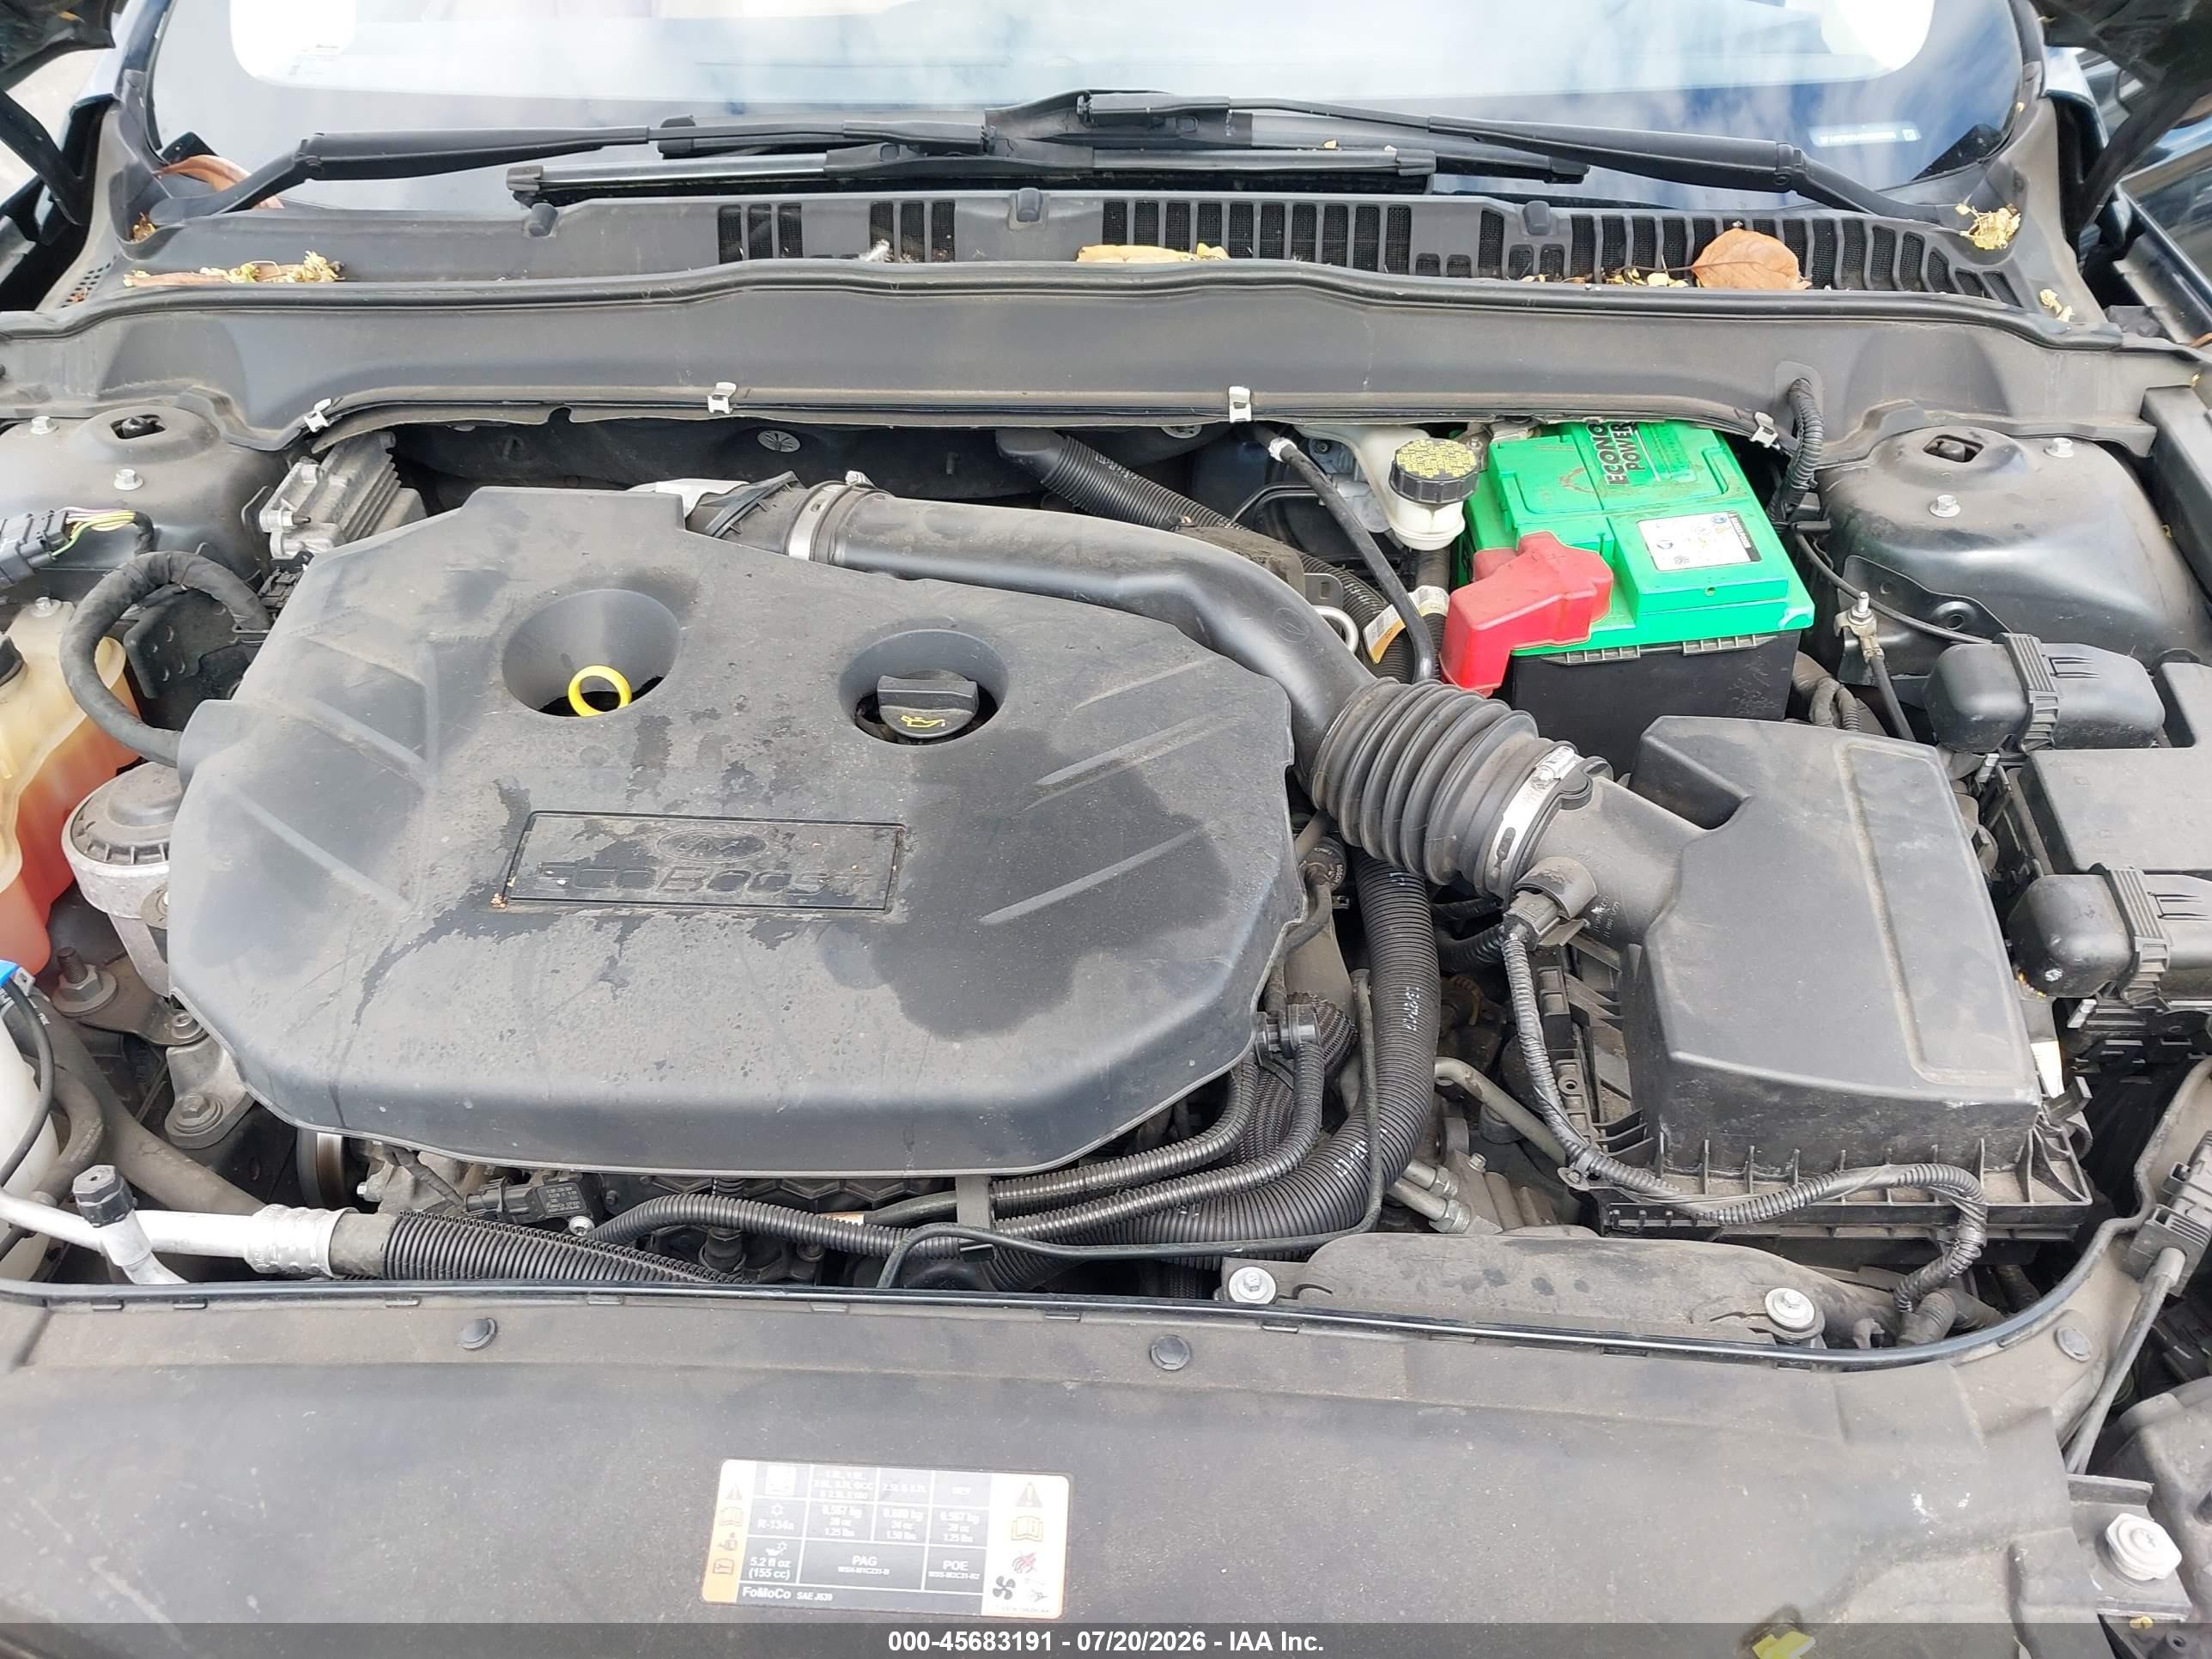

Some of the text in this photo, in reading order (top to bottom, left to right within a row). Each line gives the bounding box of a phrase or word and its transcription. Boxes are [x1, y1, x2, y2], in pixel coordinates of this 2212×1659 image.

[1586, 418, 1630, 485] ECONO
[1608, 419, 1646, 472] POWER
[757, 1518, 795, 1531] R-134a
[750, 1556, 792, 1568] 5.2 fl oz
[851, 1555, 878, 1566] PAG
[942, 1559, 969, 1571] POE
[749, 1568, 791, 1580] (155 cc)
[742, 1586, 792, 1600] FoMoCo
